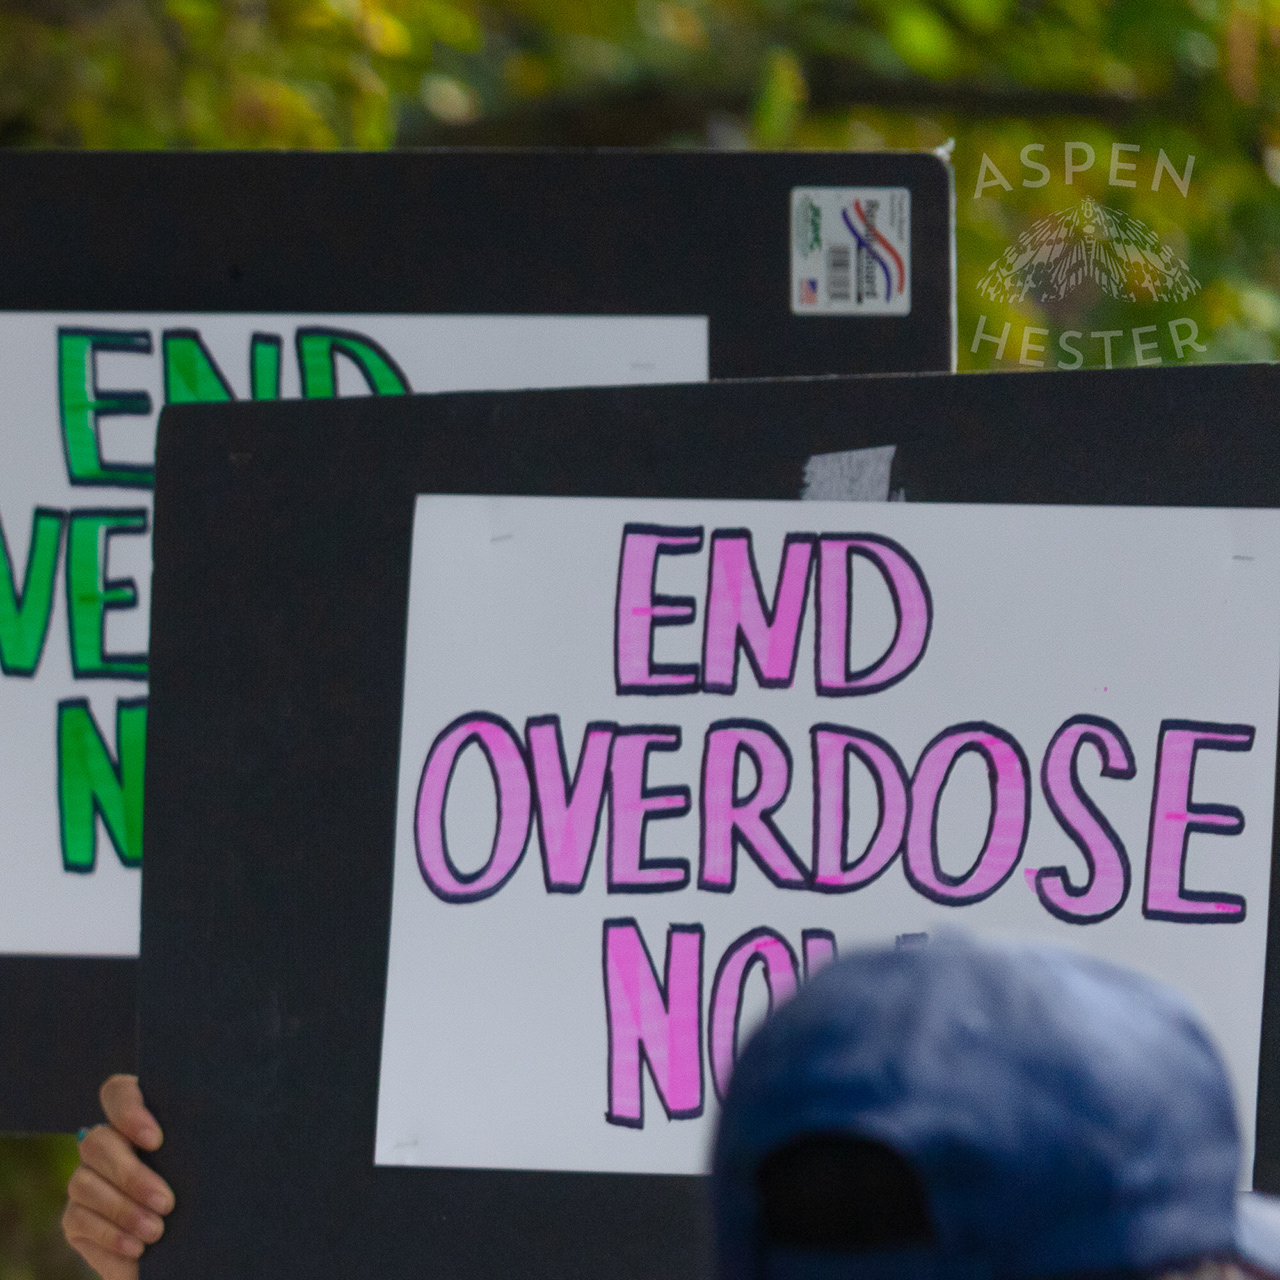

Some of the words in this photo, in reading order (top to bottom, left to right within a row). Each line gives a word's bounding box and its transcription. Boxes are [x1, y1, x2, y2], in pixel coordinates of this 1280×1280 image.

[613, 522, 933, 697] END
[413, 711, 1256, 924] OVERDOSE
[602, 917, 929, 1129] NO
